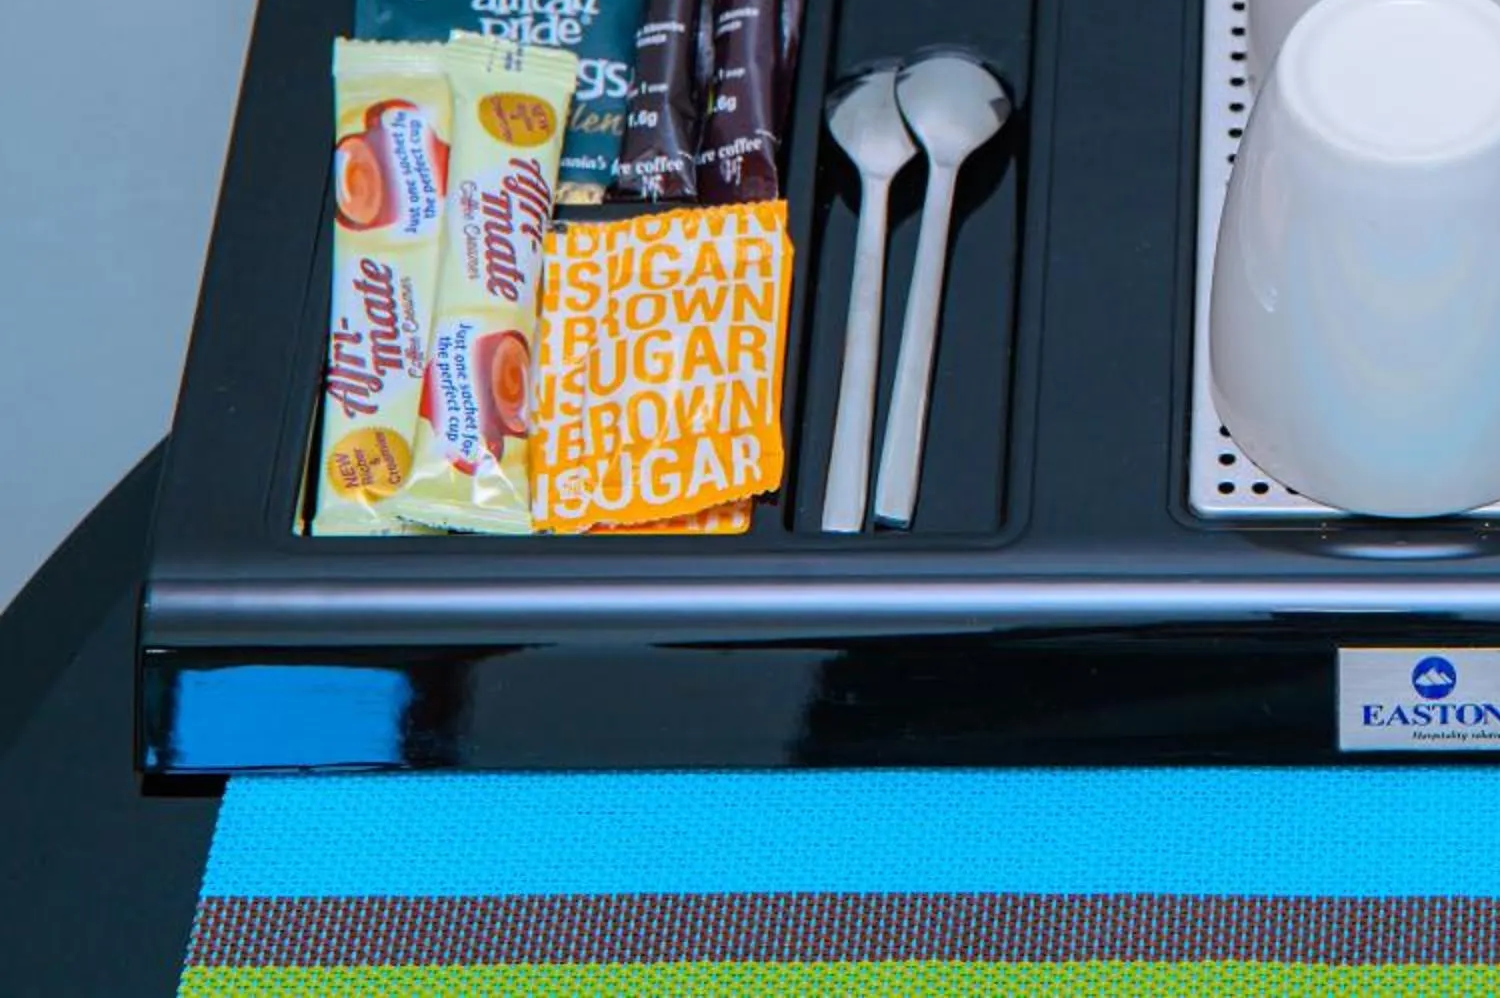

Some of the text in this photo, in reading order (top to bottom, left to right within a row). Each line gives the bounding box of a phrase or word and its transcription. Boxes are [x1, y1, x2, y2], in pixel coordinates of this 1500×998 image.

[575, 57, 628, 101] gs
[408, 119, 436, 220] the perfect cup
[635, 155, 684, 175] coffee
[718, 136, 762, 159] coffee
[481, 190, 528, 302] mate
[353, 258, 405, 378] mate
[455, 322, 474, 350] Just
[436, 336, 460, 443] the perfect cup
[454, 354, 468, 379] one
[461, 383, 479, 431] sachet
[334, 452, 360, 489] NEW
[554, 434, 763, 519] SUGAR
